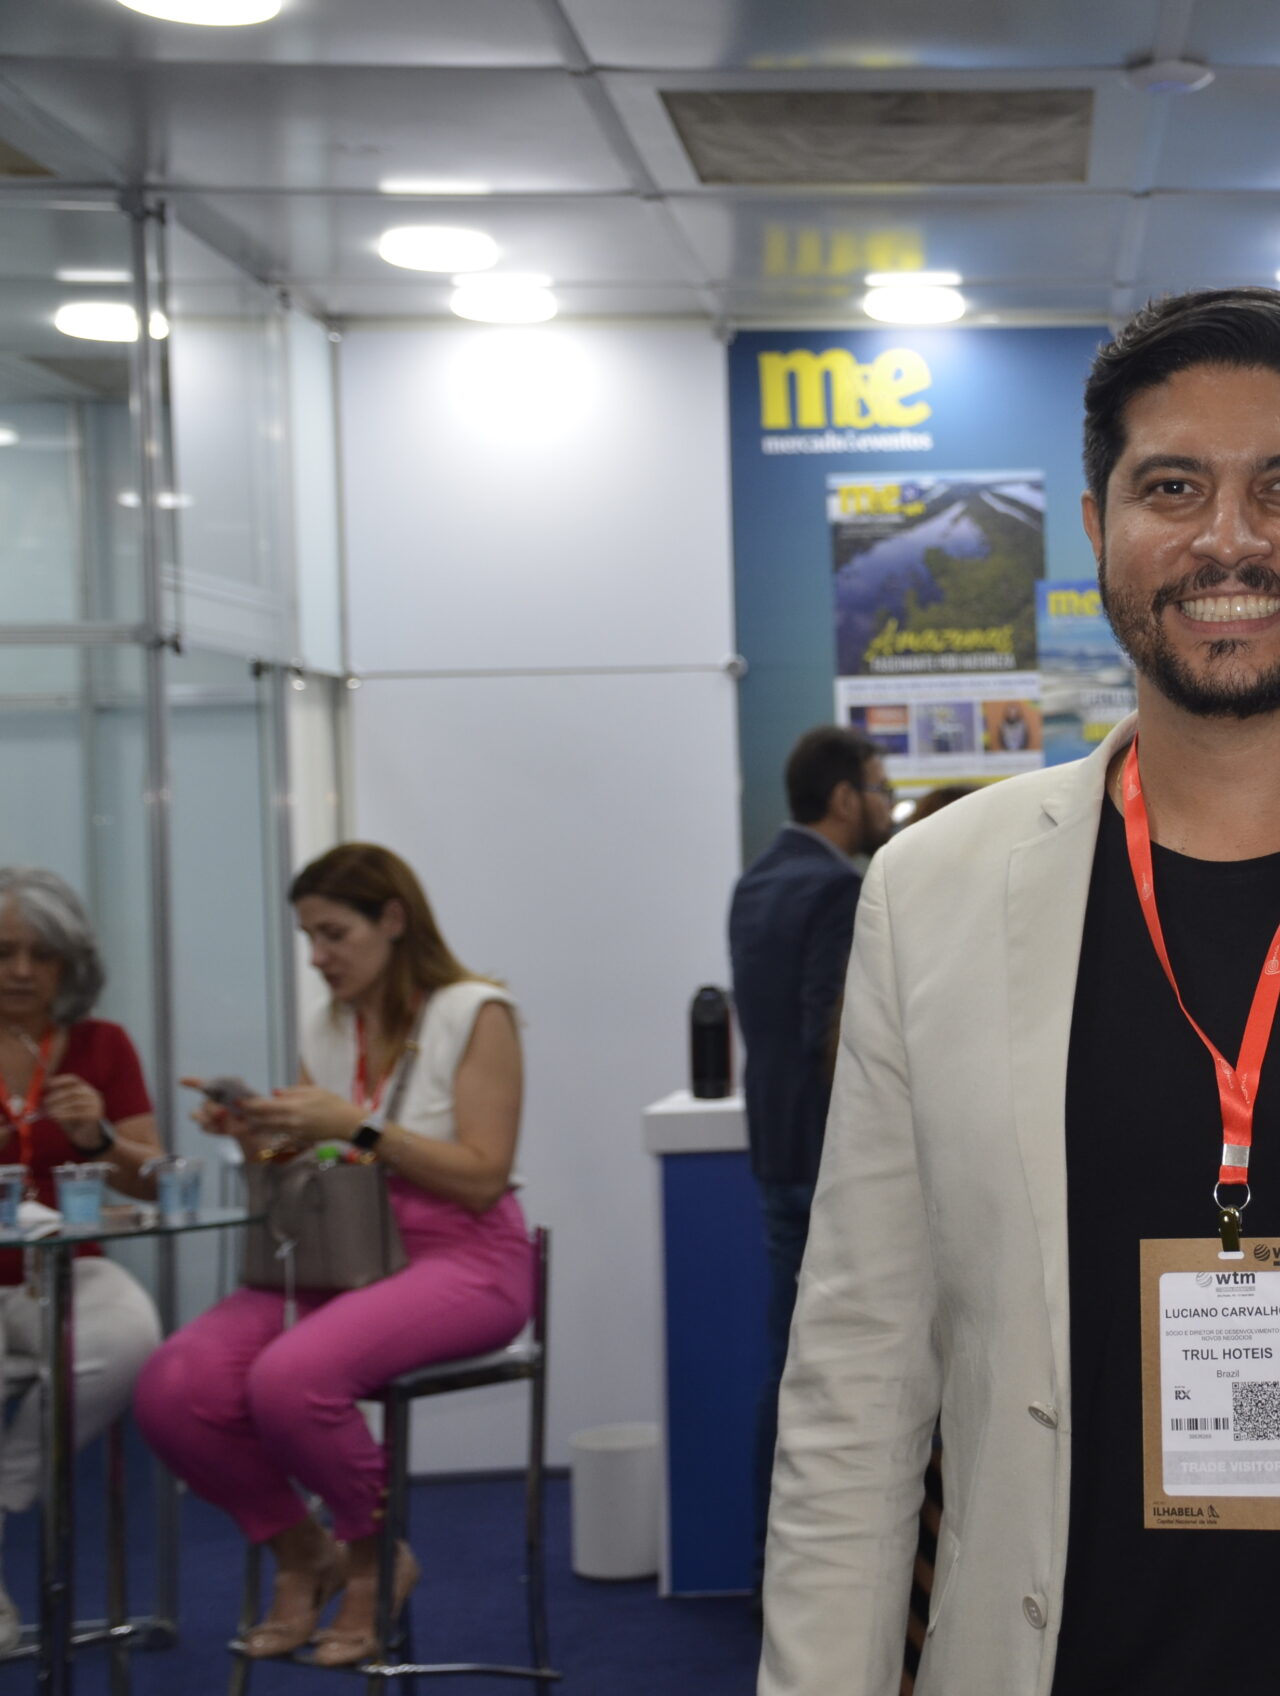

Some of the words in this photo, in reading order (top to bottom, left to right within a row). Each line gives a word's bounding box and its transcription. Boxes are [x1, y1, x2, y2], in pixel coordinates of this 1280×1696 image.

[1216, 1271, 1256, 1285] wtm
[1165, 1307, 1218, 1319] LUCIANO
[1182, 1349, 1218, 1361] TRUL
[1222, 1347, 1273, 1360] HOTEIS
[1216, 1369, 1240, 1379] Brazil
[1174, 1389, 1192, 1400] RX
[1181, 1462, 1226, 1473] TRADE
[1153, 1506, 1204, 1517] ILHABELA
